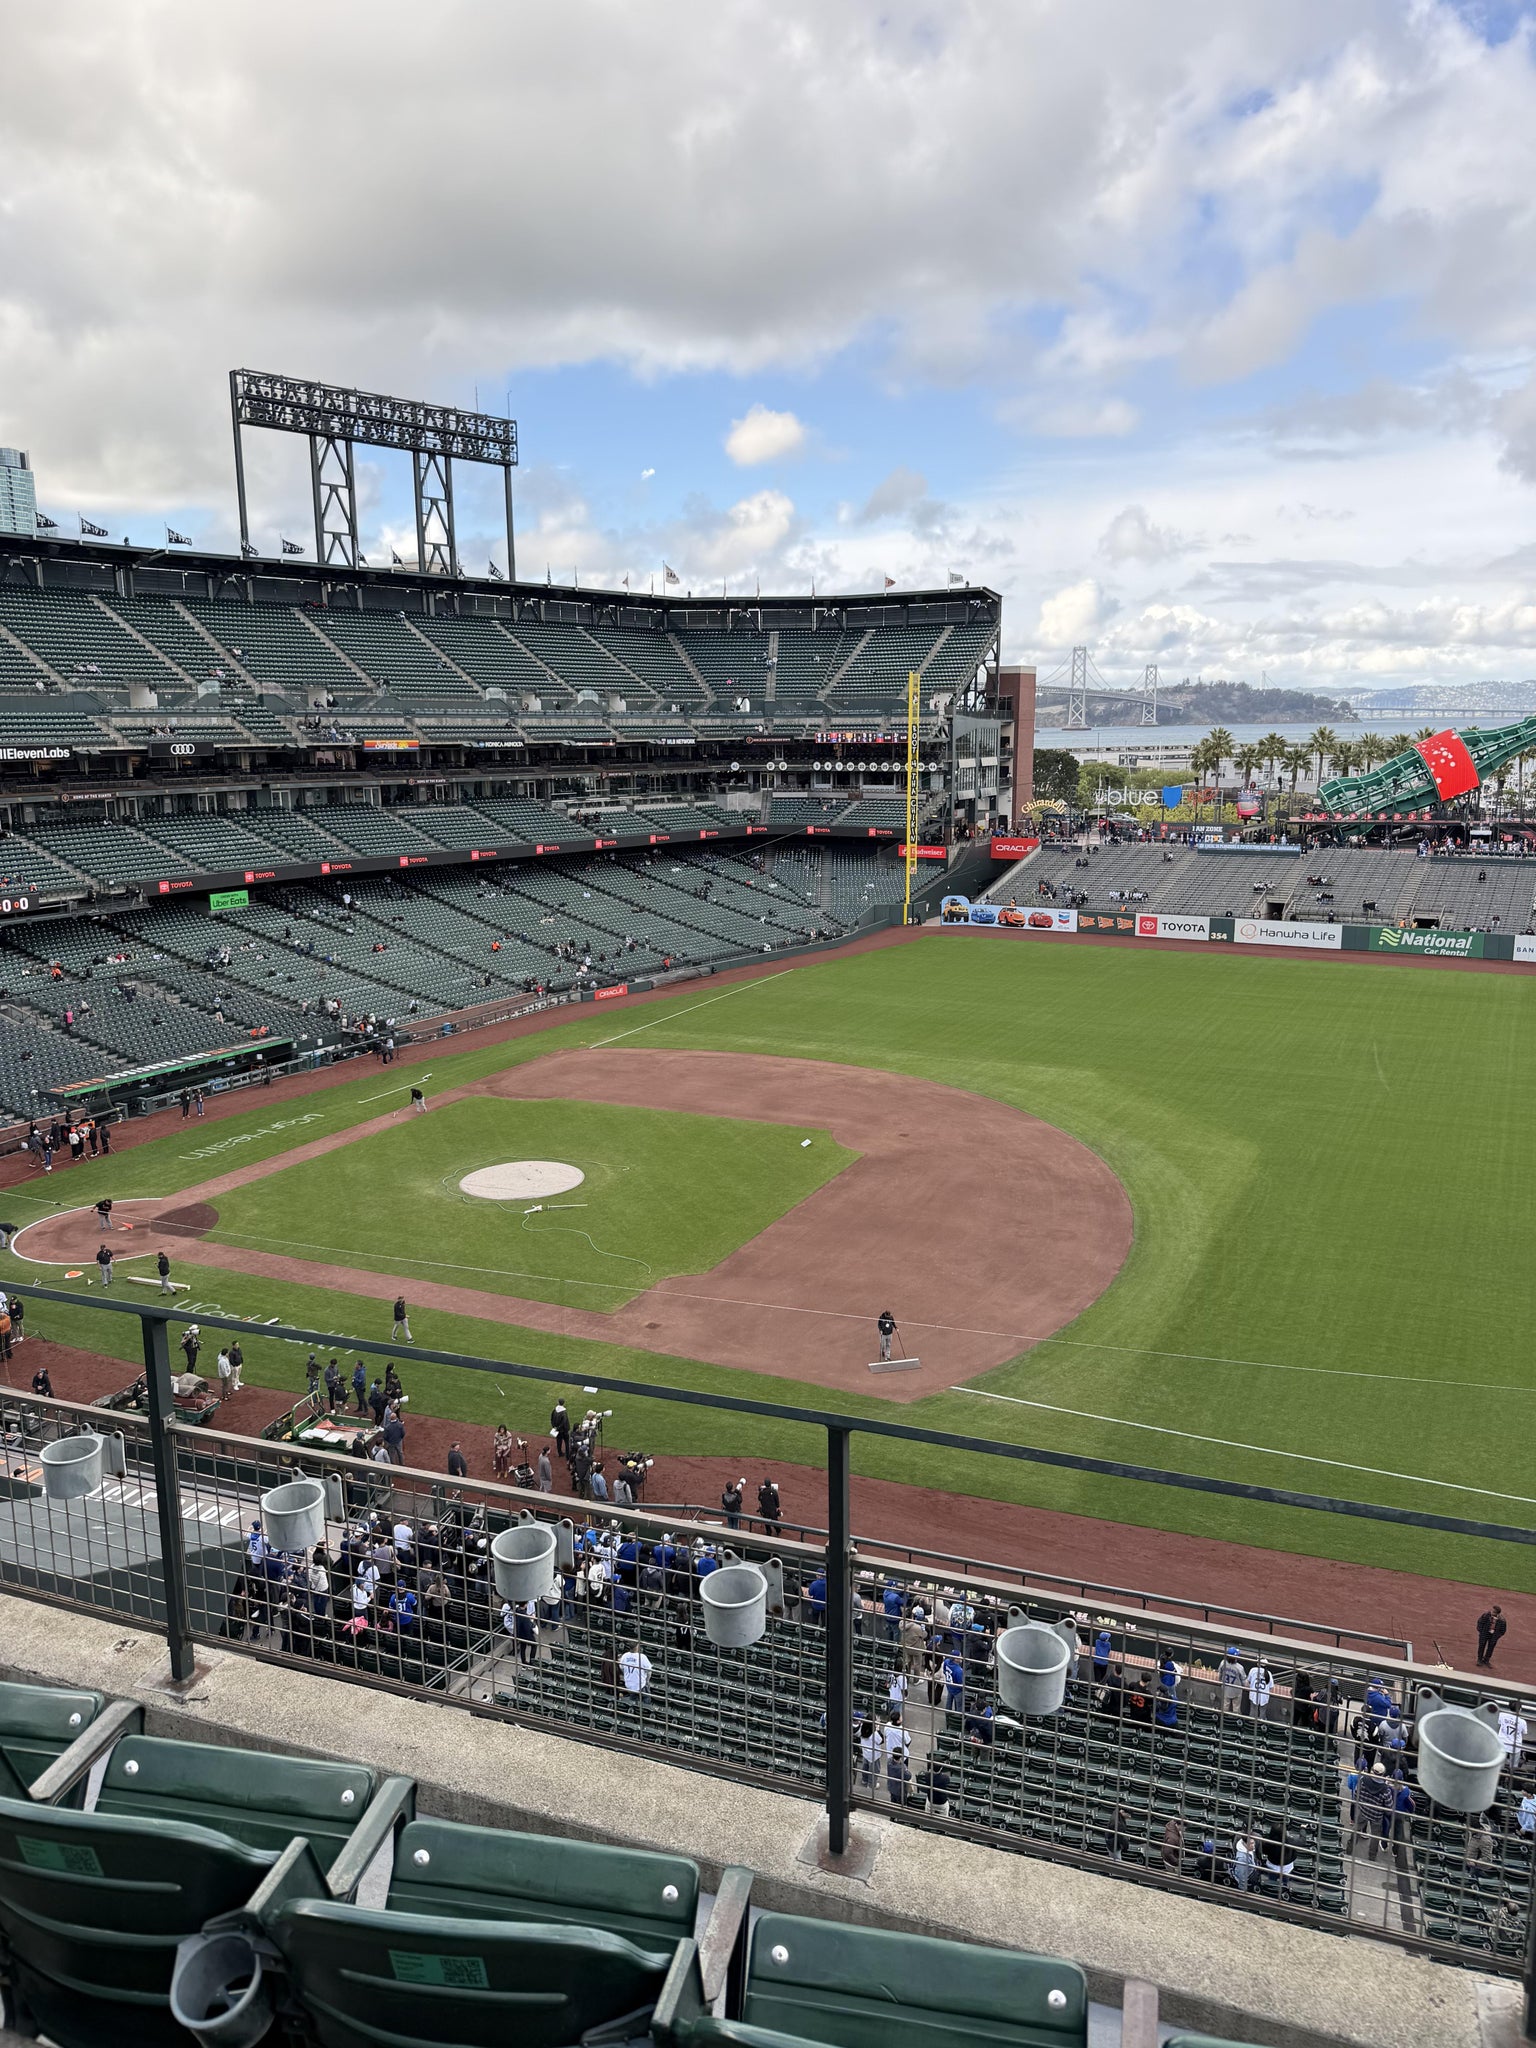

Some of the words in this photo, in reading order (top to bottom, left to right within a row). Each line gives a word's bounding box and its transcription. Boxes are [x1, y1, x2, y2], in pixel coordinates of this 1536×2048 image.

[1108, 786, 1158, 806] blue
[1022, 798, 1066, 814] Ghirardelli
[3, 899, 11, 912] 0
[20, 898, 28, 910] 0
[1162, 922, 1205, 932] TOYOTA
[1260, 928, 1309, 939] Hanwha
[1313, 931, 1336, 941] Life
[1400, 932, 1472, 949] National
[600, 988, 623, 997] ORACLE
[397, 1602, 406, 1612] 31
[1224, 1674, 1236, 1684] 37
